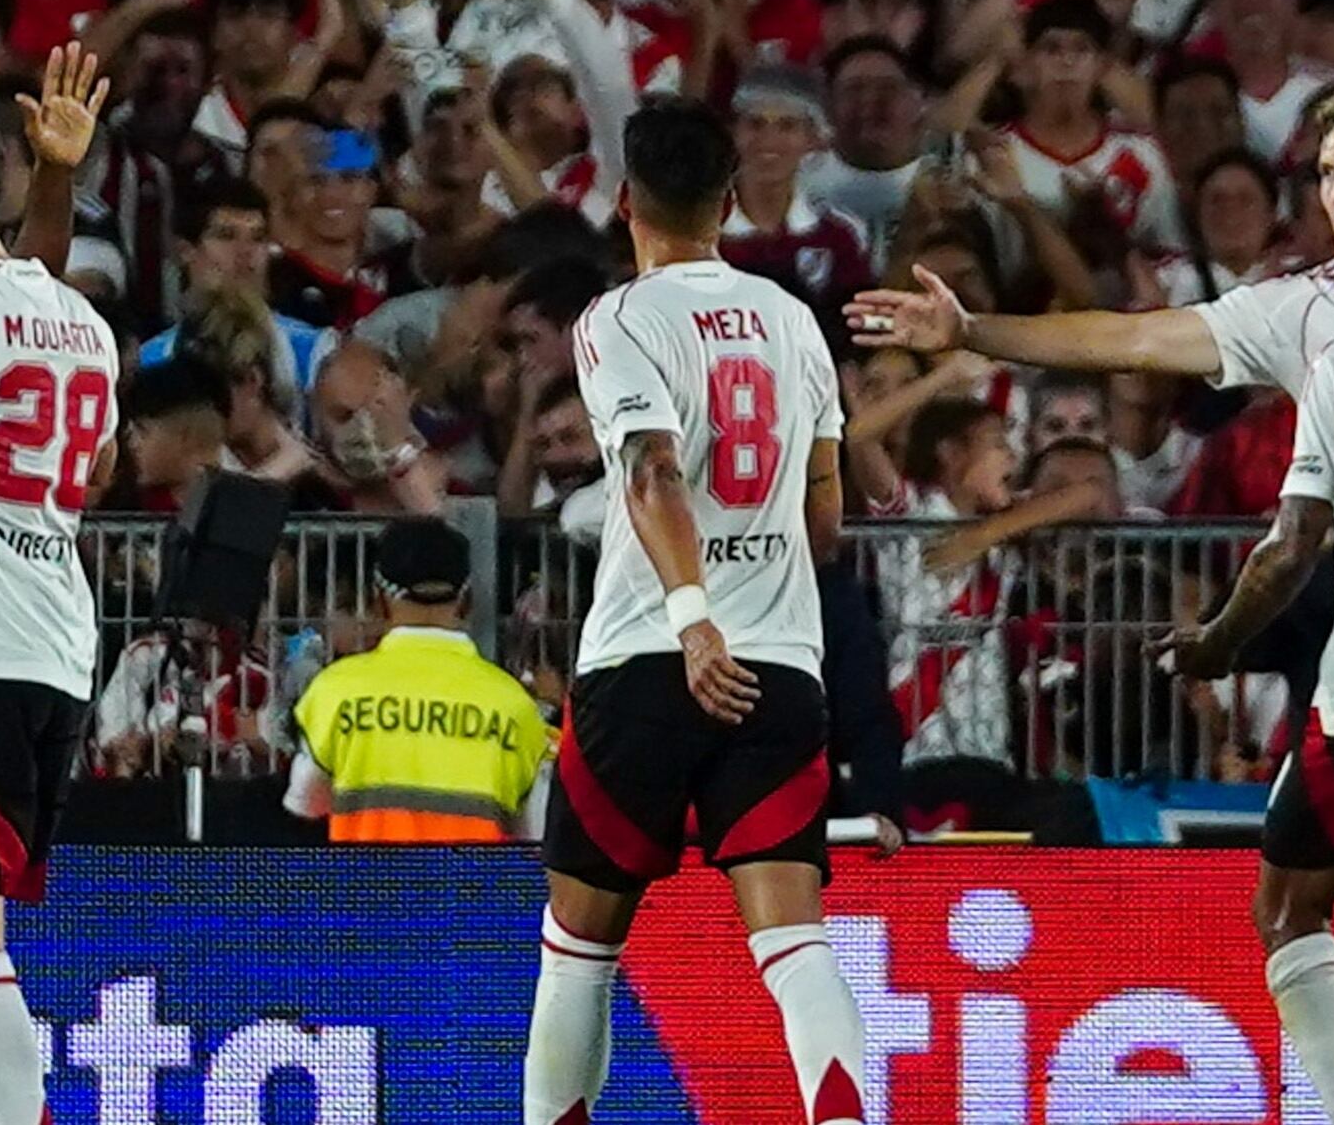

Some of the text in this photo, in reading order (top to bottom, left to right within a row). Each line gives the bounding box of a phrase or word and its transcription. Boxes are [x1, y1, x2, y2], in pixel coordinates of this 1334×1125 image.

[693, 309, 768, 341] MEZA
[708, 356, 782, 509] 8
[338, 696, 521, 751] SEGURIDAD
